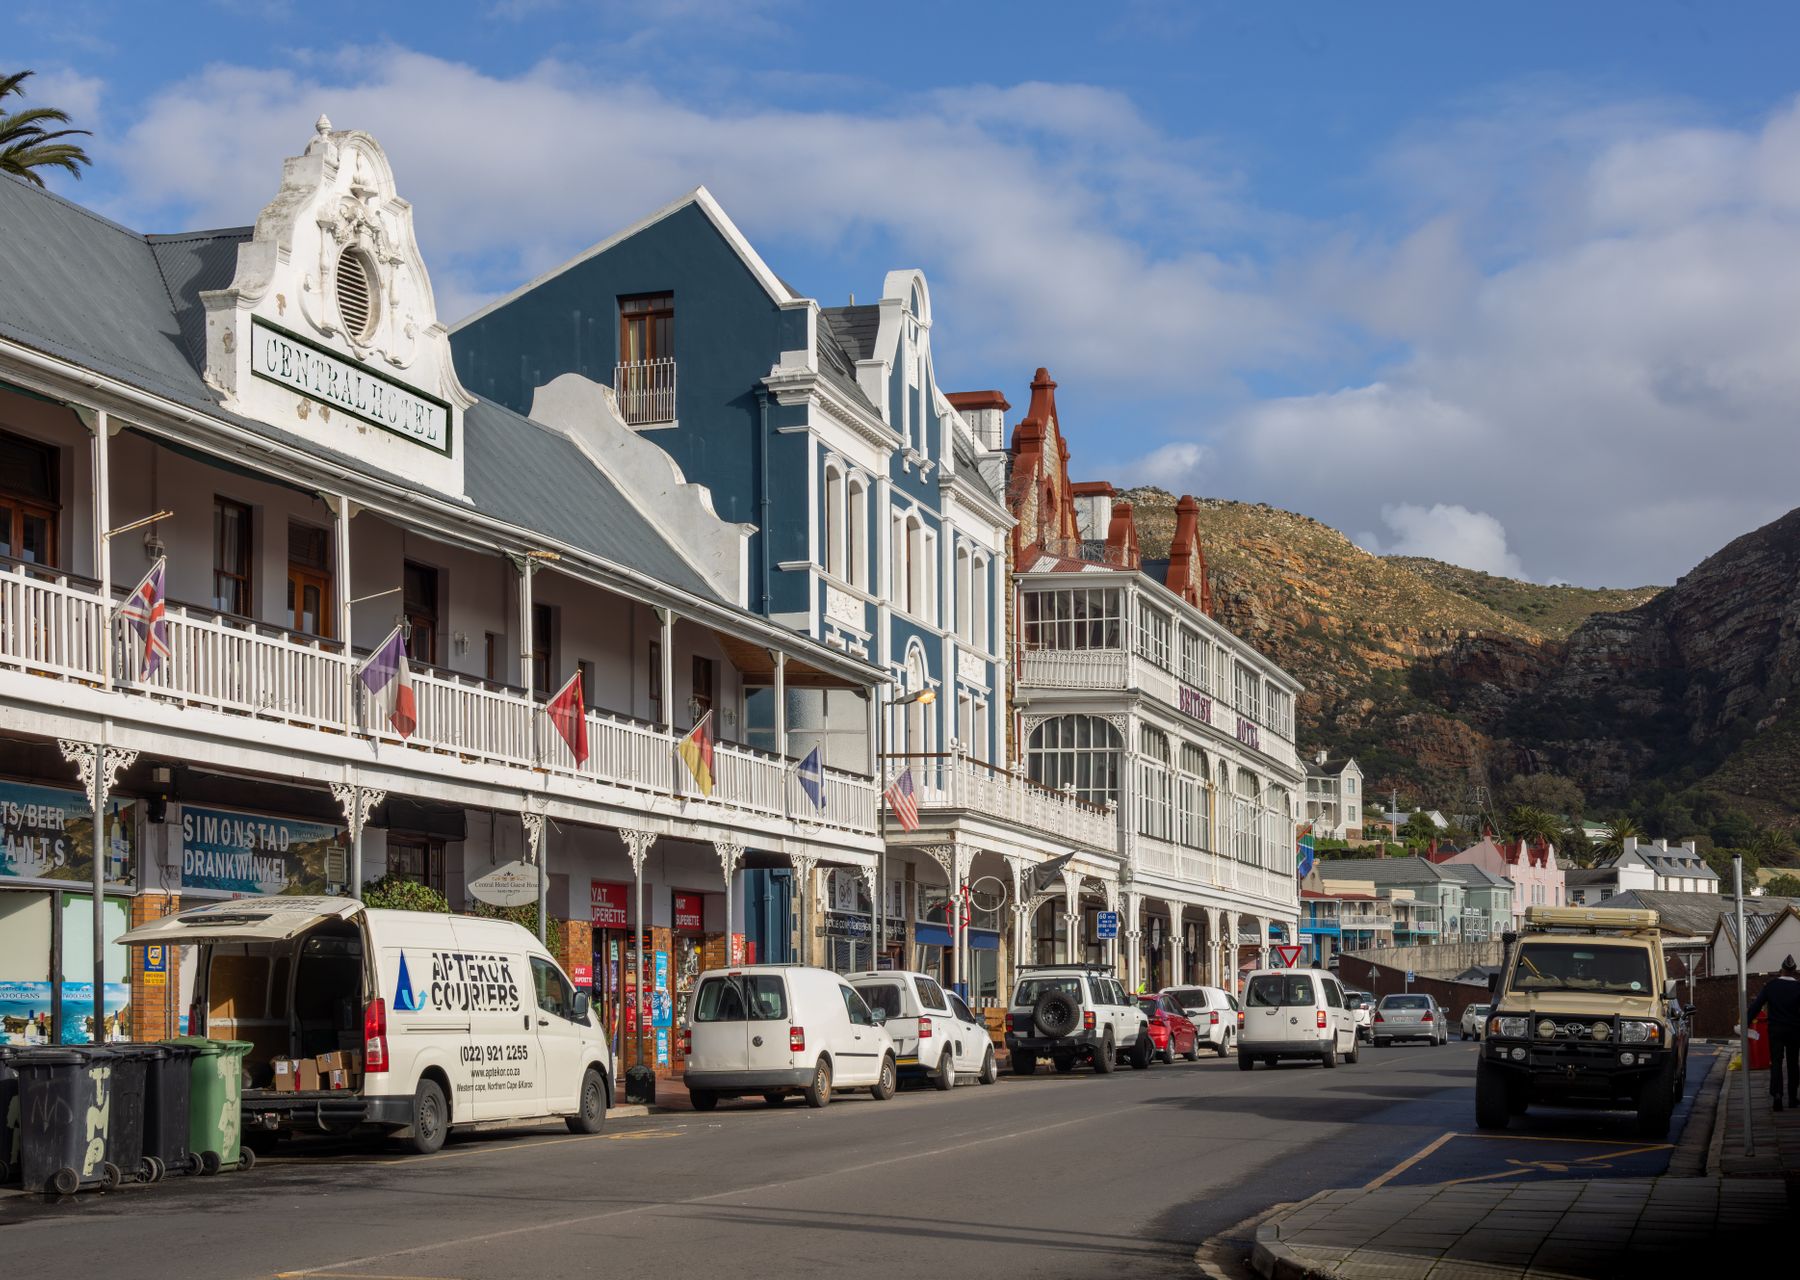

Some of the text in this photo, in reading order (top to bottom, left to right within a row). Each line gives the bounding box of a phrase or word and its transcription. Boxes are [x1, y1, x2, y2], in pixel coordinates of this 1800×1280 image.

[266, 338, 437, 441] CENTRAL HOTEL
[1179, 685, 1260, 751] BRITISH HOTEL
[183, 813, 290, 852] SIMONSTAD
[184, 849, 289, 885] DRANKWINKEL
[592, 887, 608, 903] YAT
[592, 907, 626, 924] UPERETTE
[432, 952, 514, 983] APTEKOR
[431, 982, 520, 1012] COURIERS
[460, 1045, 528, 1066] (022) 921 2255
[471, 1067, 521, 1079] www.aptekor.co.za
[487, 1081, 506, 1090] Northern
[506, 1080, 518, 1091] Cape
